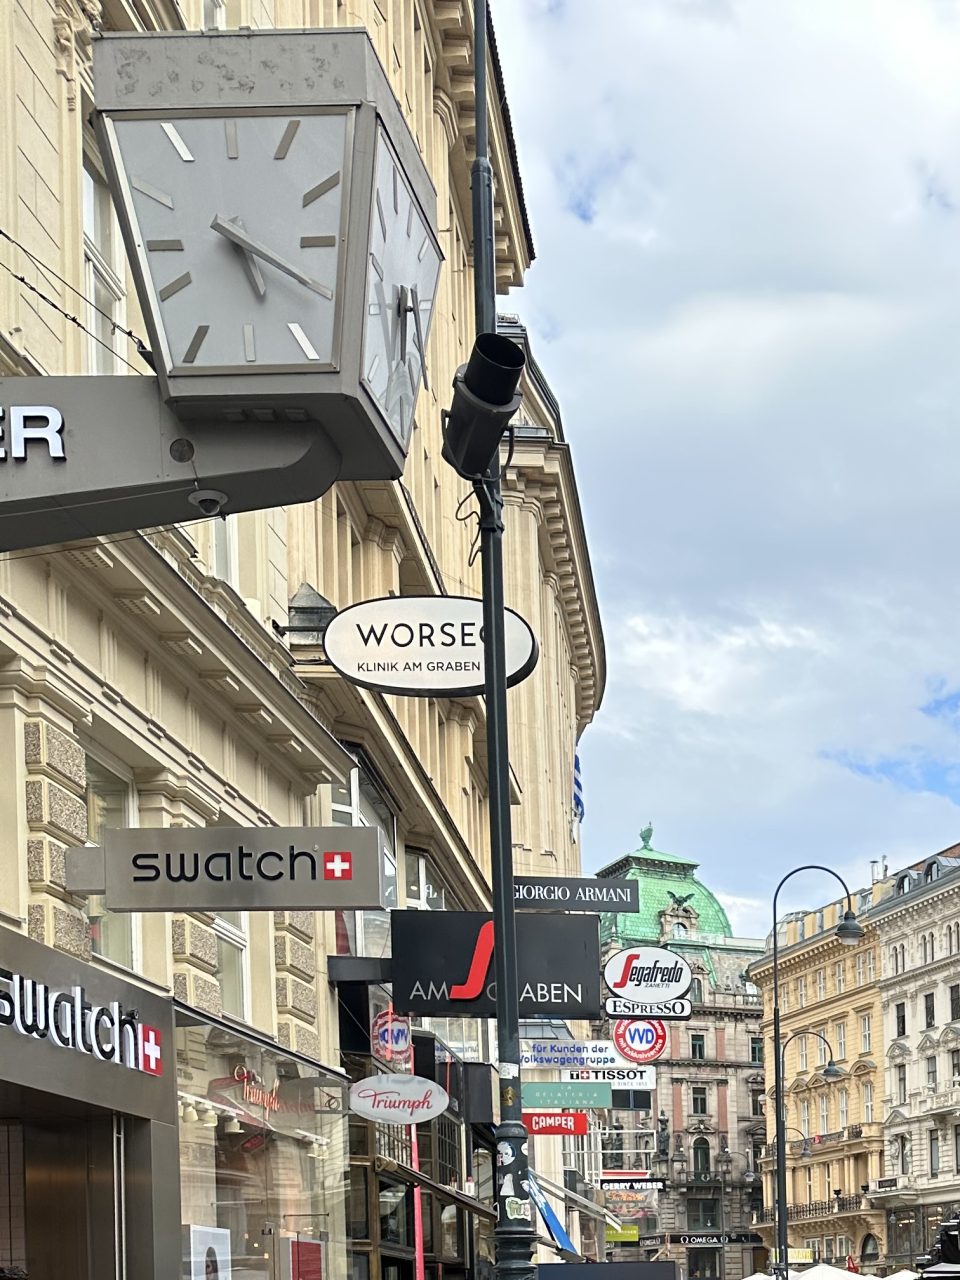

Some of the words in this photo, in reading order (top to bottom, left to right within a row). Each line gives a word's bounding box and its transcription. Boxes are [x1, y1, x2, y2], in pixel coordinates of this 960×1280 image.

[356, 622, 484, 647] WORSE
[357, 662, 398, 672] KLINIK
[403, 662, 422, 672] AM
[426, 661, 481, 672] GRABEN
[131, 845, 317, 882] swatch
[575, 887, 632, 902] ARMANI
[613, 953, 684, 988] Segafredo
[409, 980, 449, 1001] AM
[611, 1000, 685, 1015] ESPRESSO
[628, 1027, 655, 1045] VVD
[532, 1043, 547, 1053] für
[550, 1043, 589, 1053] Kunden
[591, 1044, 609, 1053] der
[591, 1070, 647, 1080] TISSOT
[358, 1089, 433, 1117] Triumph
[532, 1116, 575, 1131] CAMPER
[602, 1181, 632, 1190] GERRY
[633, 1181, 664, 1190] WEBER
